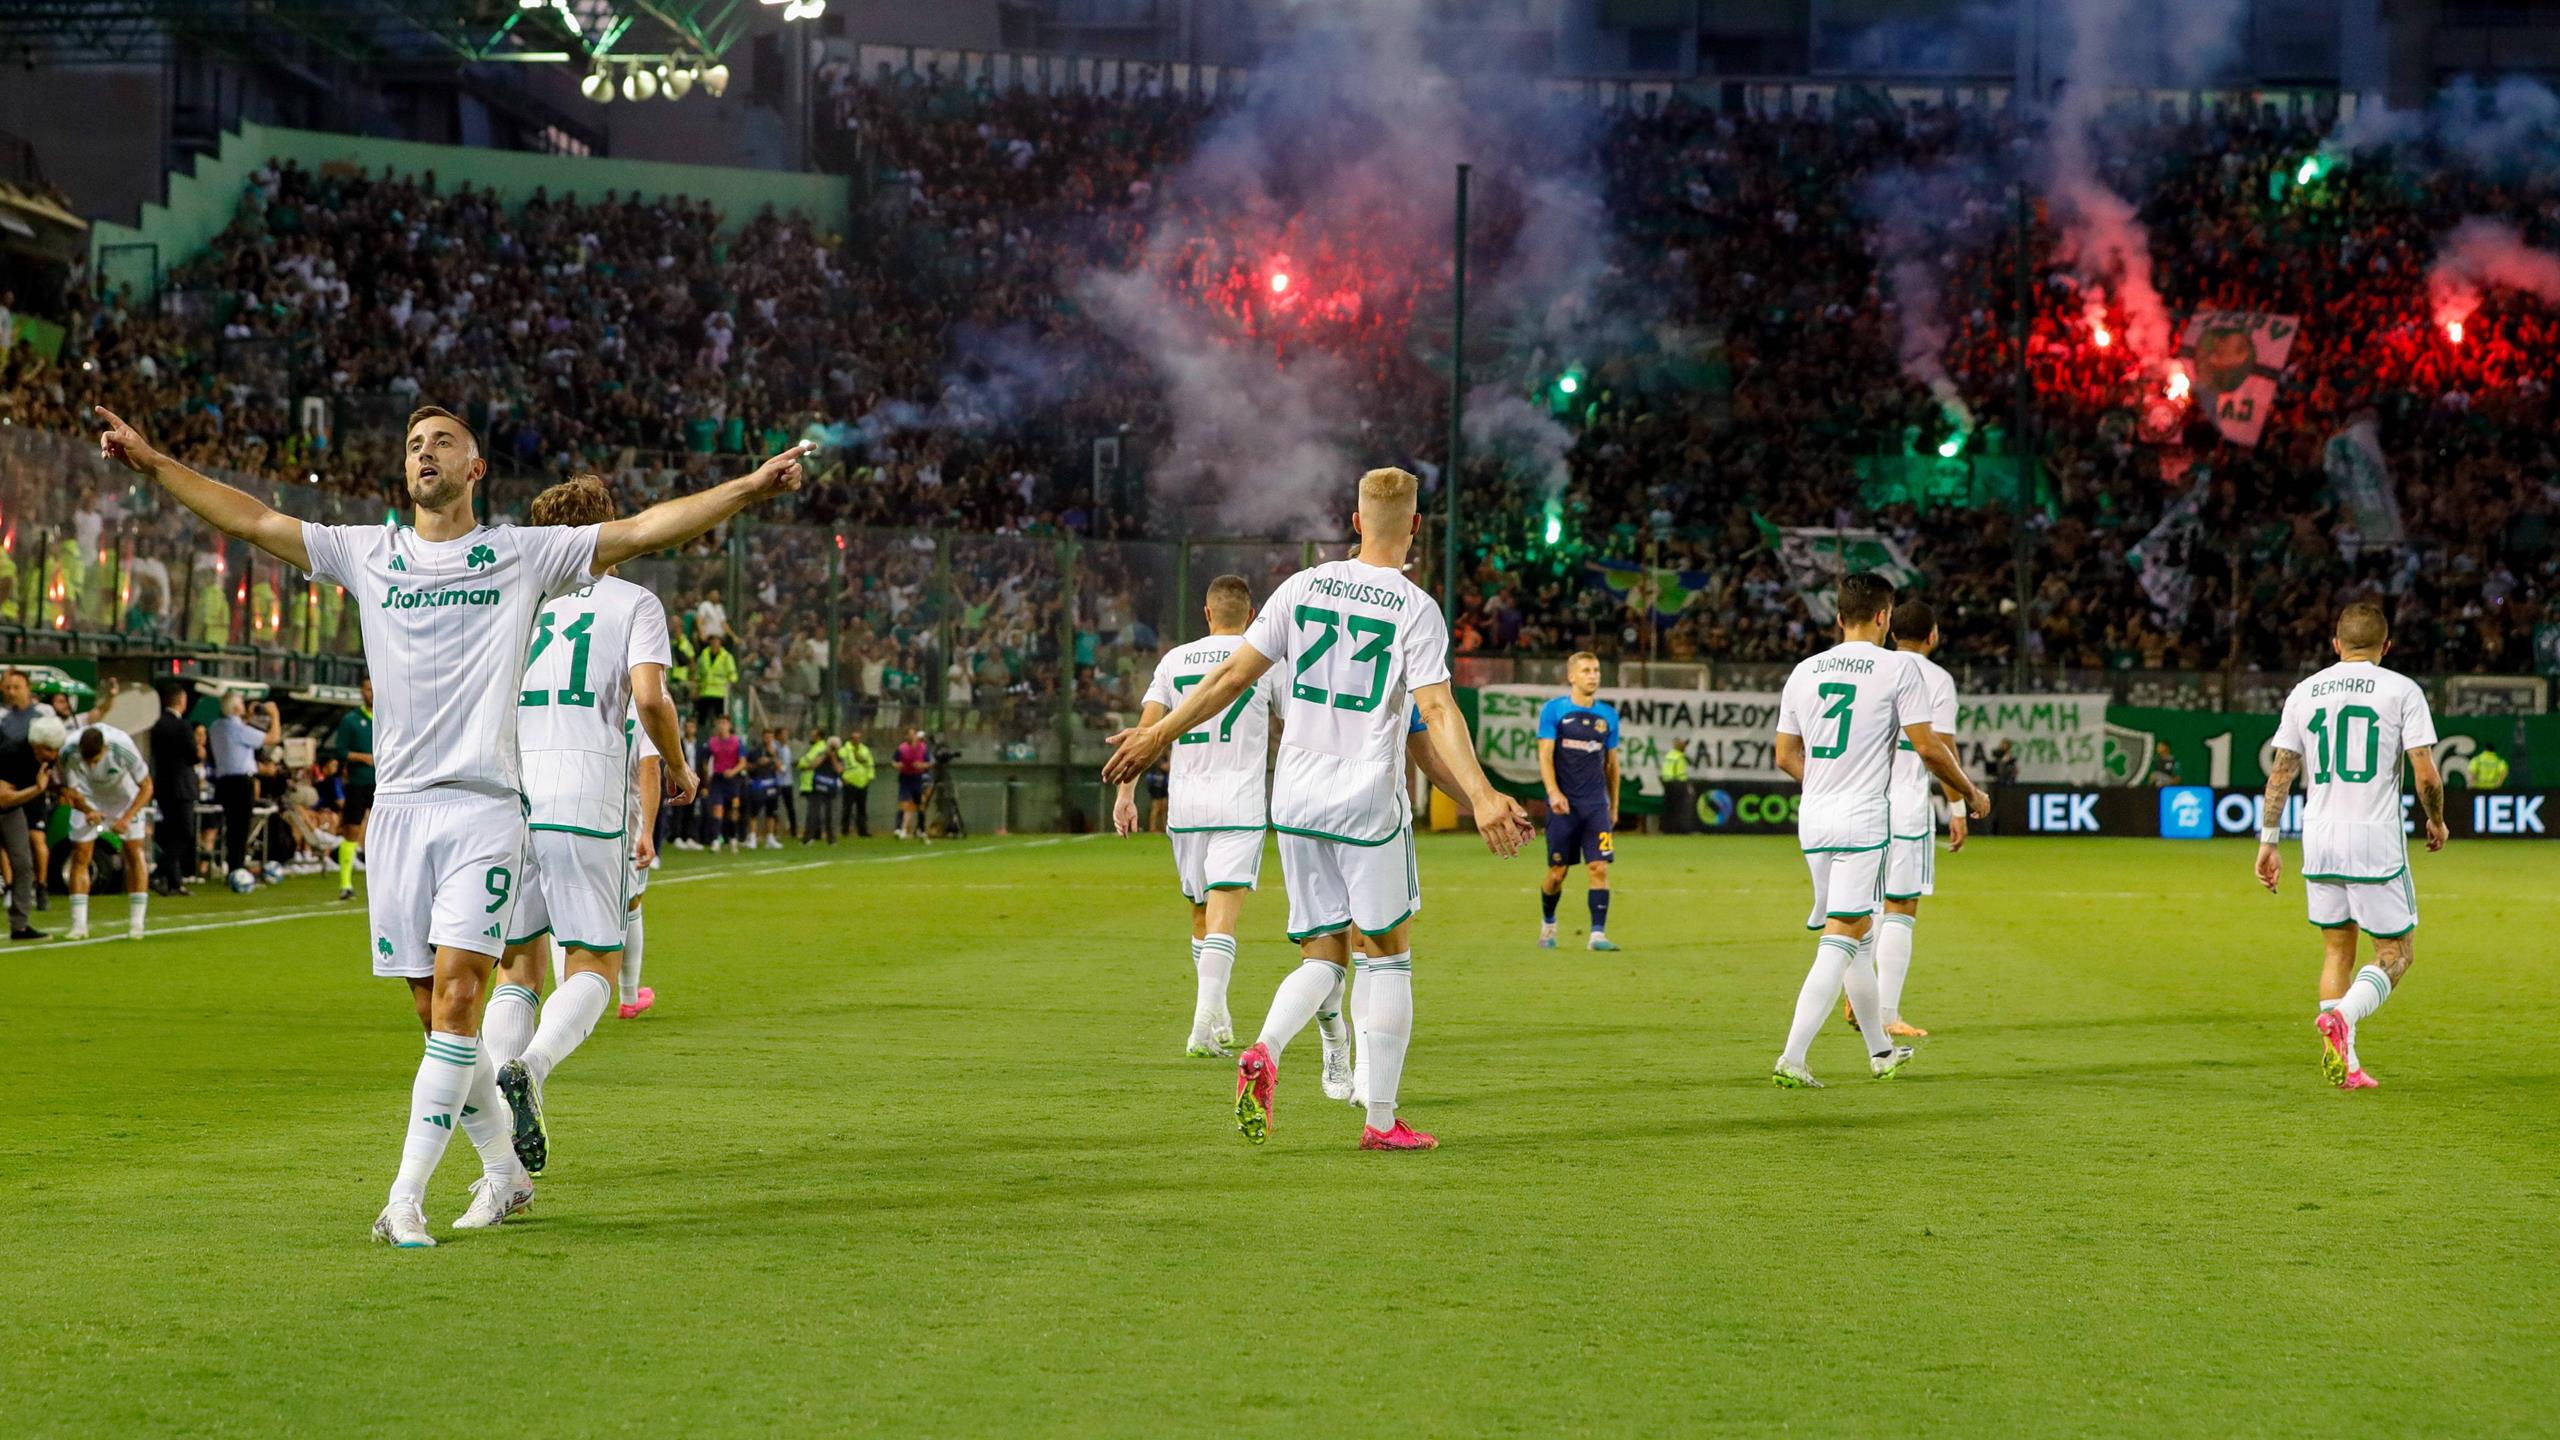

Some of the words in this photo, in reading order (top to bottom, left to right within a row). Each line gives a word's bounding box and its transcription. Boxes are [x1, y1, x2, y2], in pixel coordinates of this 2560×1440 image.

[381, 586, 500, 609] Stoiximan
[519, 611, 596, 708] 21
[1292, 604, 1396, 713] 23
[1812, 658, 1875, 675] JUANKAR
[2311, 678, 2376, 697] BERNARD
[1811, 682, 1857, 759] 3
[2307, 704, 2379, 785] 10
[485, 867, 511, 913] 9
